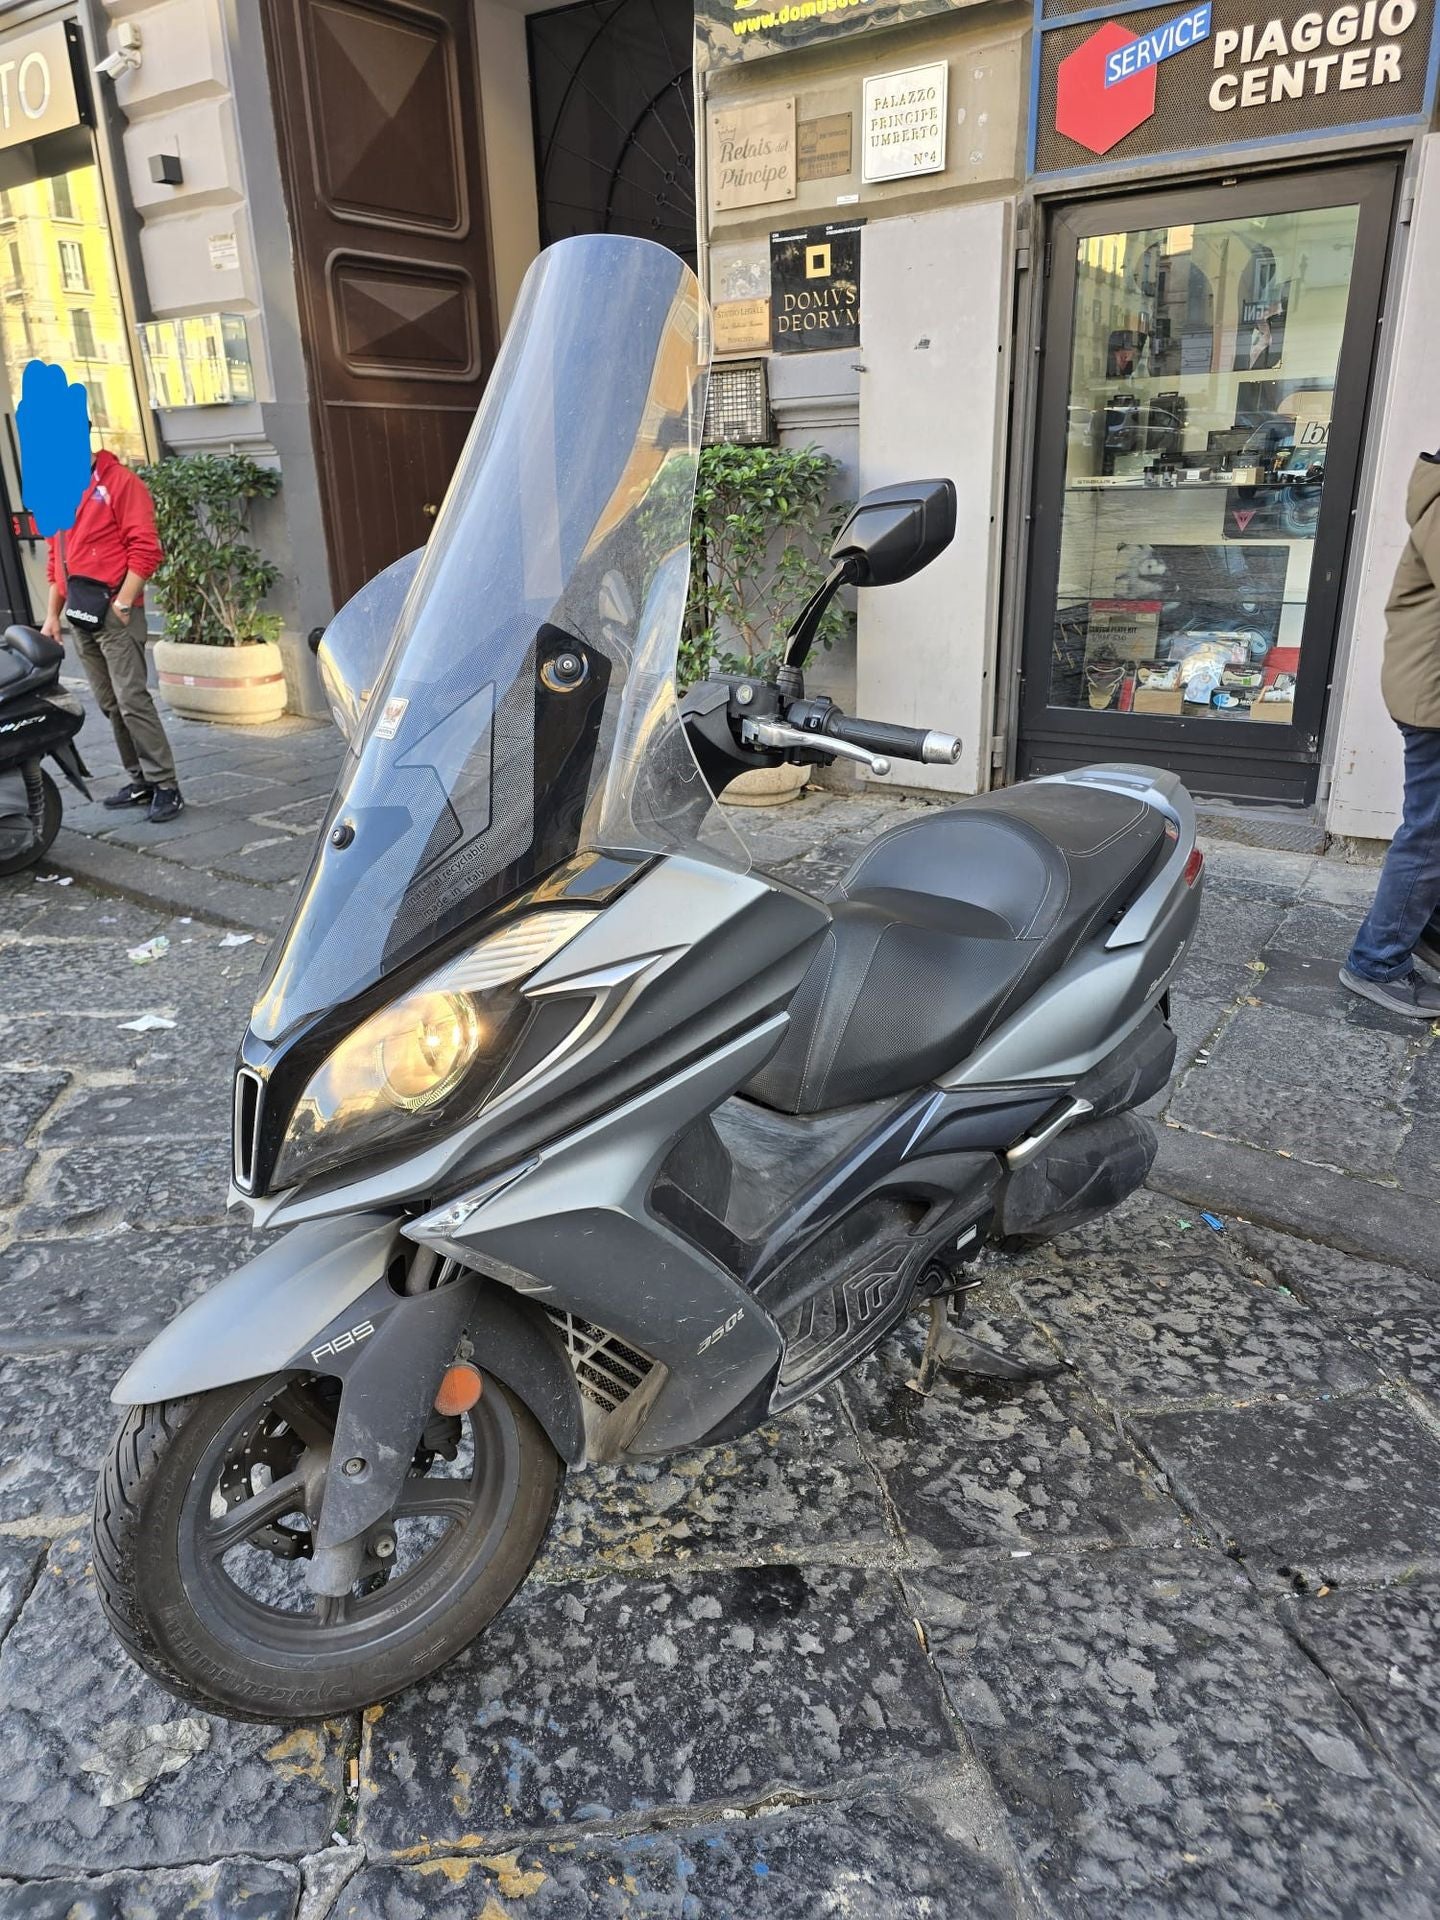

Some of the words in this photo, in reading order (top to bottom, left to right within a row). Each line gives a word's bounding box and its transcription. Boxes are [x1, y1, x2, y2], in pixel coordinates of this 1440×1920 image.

[1108, 9, 1207, 82] SERVICE
[1213, 0, 1417, 69] PIAGGIO
[1208, 44, 1402, 112] CENTER
[874, 86, 936, 111] PALAZZO
[871, 106, 938, 131] PRINCIPE
[871, 124, 938, 147] UMBERTO
[719, 138, 772, 163] Relais
[775, 140, 789, 153] del
[719, 164, 788, 191] Principe
[784, 287, 856, 312] DOMVS
[66, 608, 98, 624] adidas
[405, 873, 442, 908] material
[442, 843, 487, 879] recyclable
[423, 896, 448, 918] made
[451, 886, 461, 897] in
[464, 866, 487, 886] Italy
[311, 1320, 375, 1364] ABS
